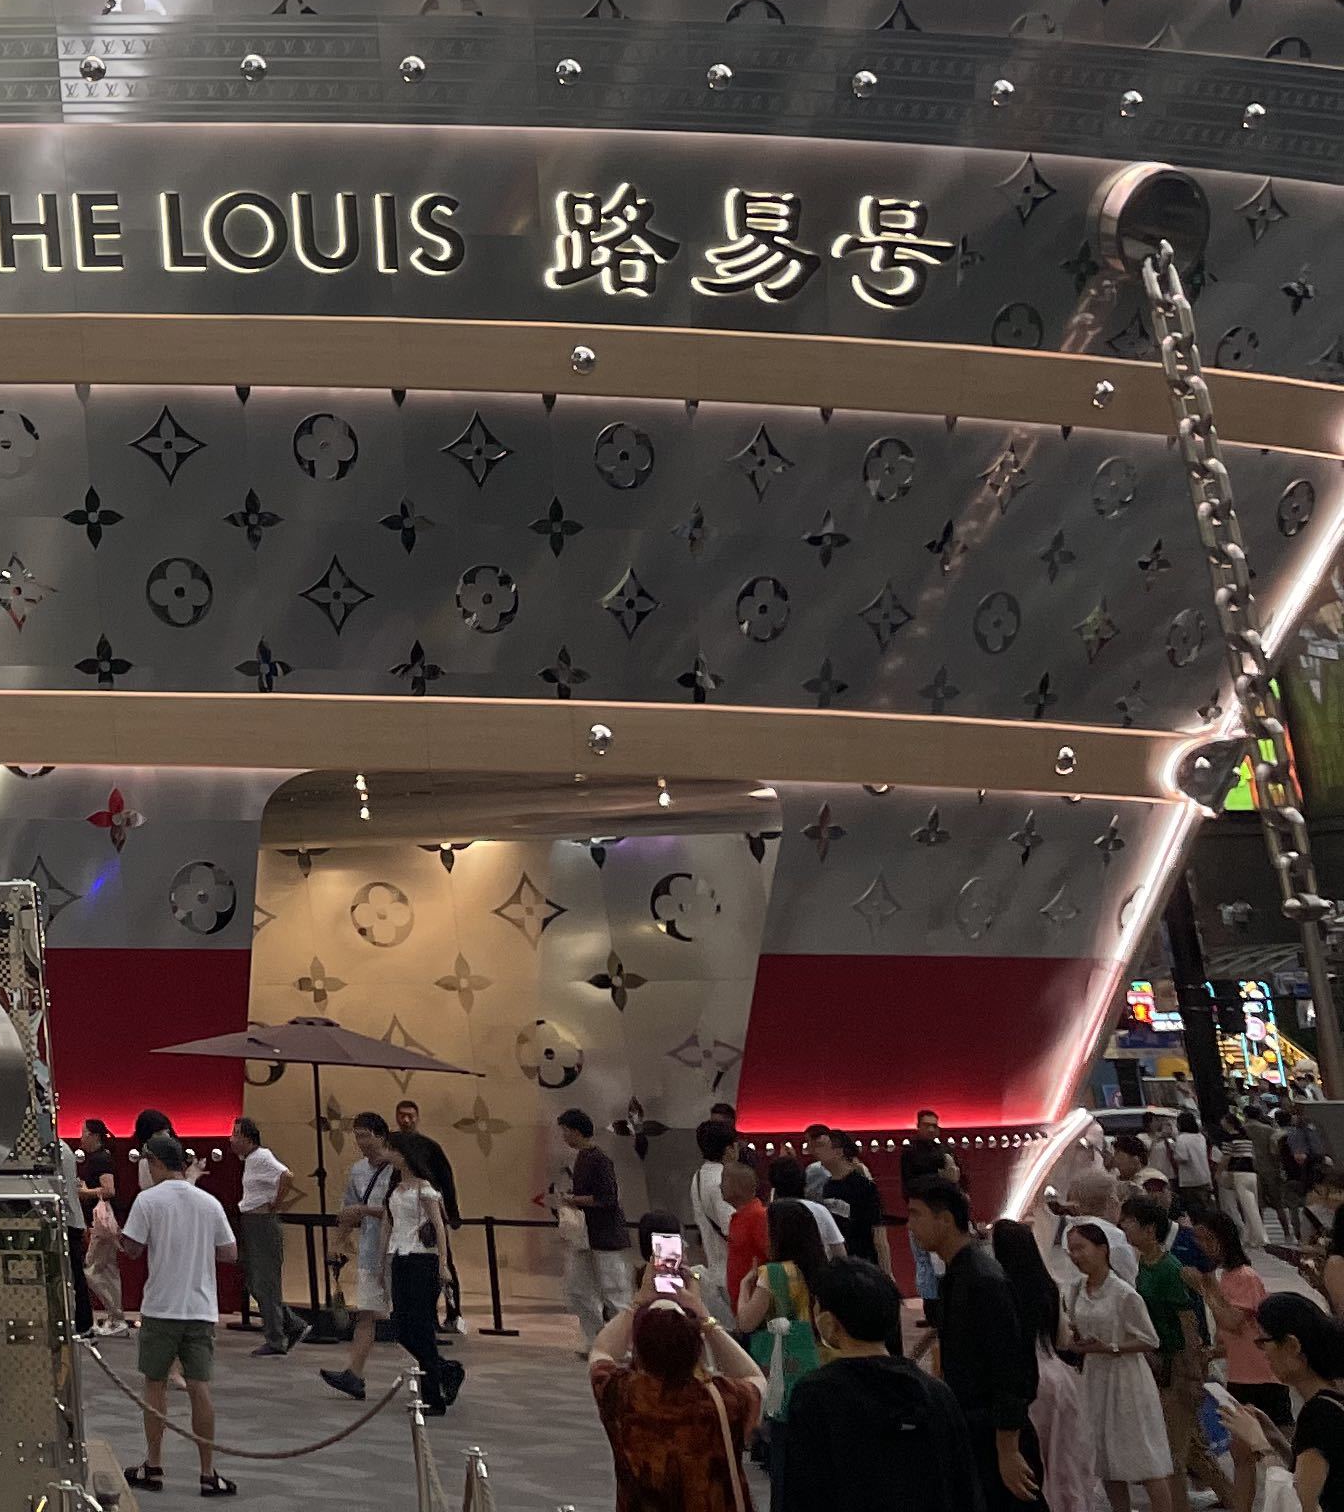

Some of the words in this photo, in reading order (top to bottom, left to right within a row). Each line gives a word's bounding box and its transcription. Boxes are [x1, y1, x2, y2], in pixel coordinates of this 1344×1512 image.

[159, 190, 467, 277] LOUIS
[543, 181, 958, 309] 路易号
